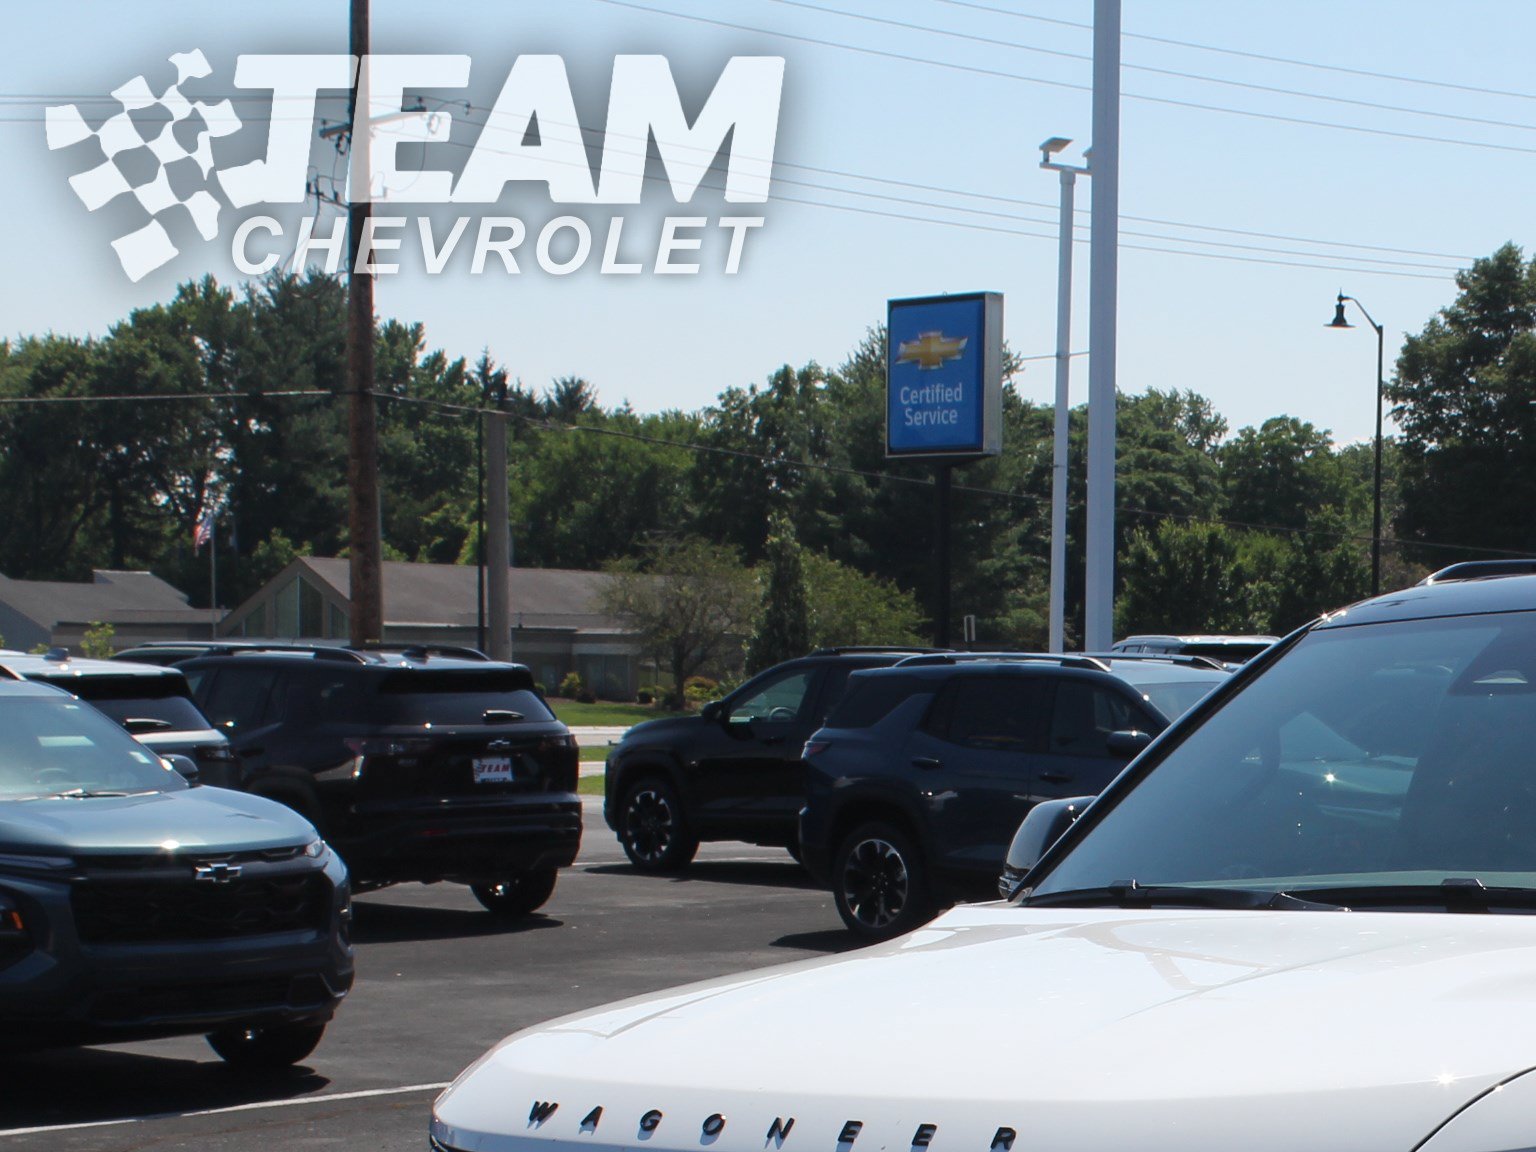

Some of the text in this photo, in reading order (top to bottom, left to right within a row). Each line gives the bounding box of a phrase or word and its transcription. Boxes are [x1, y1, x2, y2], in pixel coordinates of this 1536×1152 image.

[900, 382, 963, 404] Certified
[904, 406, 958, 426] Service
[527, 1100, 1018, 1151] WAGONEER
